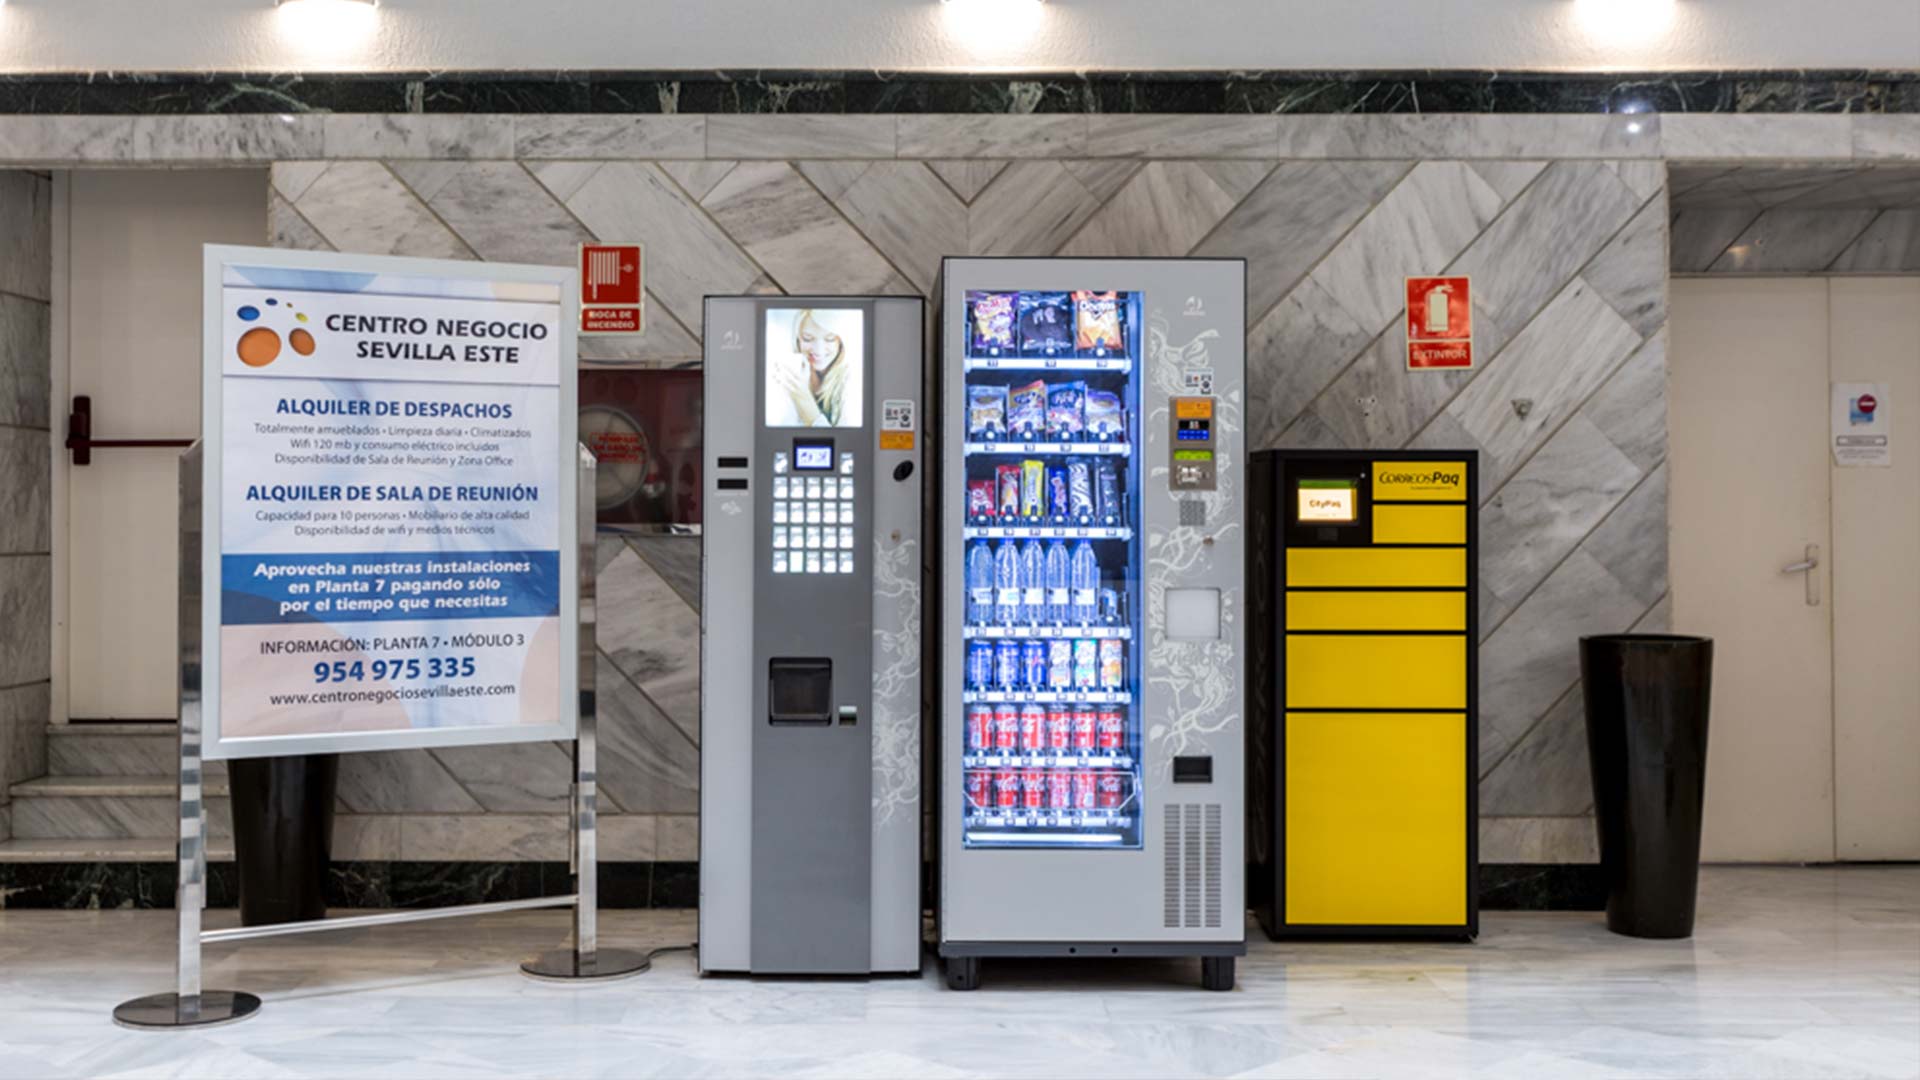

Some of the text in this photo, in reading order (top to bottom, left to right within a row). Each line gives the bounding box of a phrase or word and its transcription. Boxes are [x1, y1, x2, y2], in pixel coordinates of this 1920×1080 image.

[588, 310, 632, 319] BOCA DE
[326, 314, 547, 340] CENTRO NEGOCIO
[586, 321, 635, 329] INCENDIO
[357, 341, 519, 363] SEVILLA ESTE
[277, 399, 512, 419] ALQUILER DE DESPACHOS
[254, 423, 531, 439] Totalmente amueblados Limpieza diaria Climatizados
[289, 438, 500, 453] Wifi 120 mb y consumo eléctrico incluidos
[275, 453, 514, 468] Disponibilidad de Sala de Reunión y Zona Office
[246, 484, 538, 502] ALQUILER DE SALA DE REUNIÓN
[255, 510, 529, 523] Capacidad para 10 personas Mobiliario de alta calidad
[294, 524, 495, 537] Disponibilidad de wifi y medios técnicos
[253, 560, 531, 580] Aprovecha nuestras instalaciones
[288, 577, 501, 595] en Planta 7 pagando sólo
[280, 594, 508, 616] por el tiempo que necesitas
[261, 633, 524, 654] INFORMACIÓN: PLANTA 7 MÓDULO 3
[314, 657, 475, 683] 954 975 335
[270, 685, 515, 705] www.centronegociosevillaeste.com
